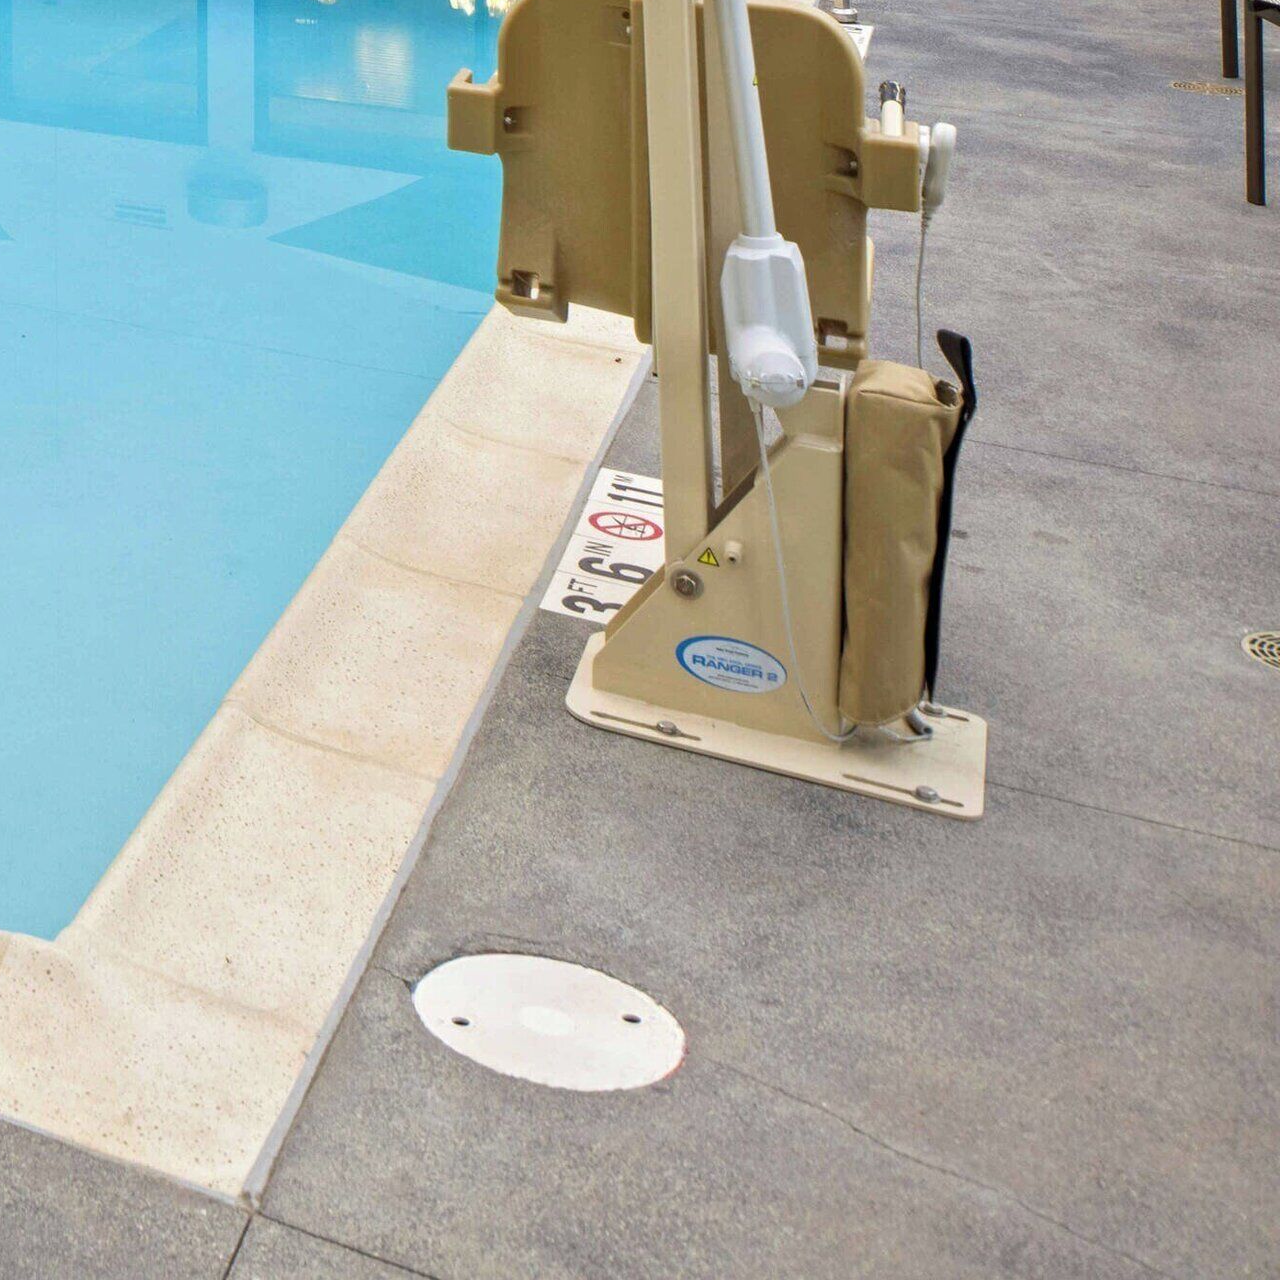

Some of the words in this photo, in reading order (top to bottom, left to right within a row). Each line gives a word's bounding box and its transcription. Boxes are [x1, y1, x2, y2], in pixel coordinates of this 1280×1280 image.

[583, 540, 613, 557] IN
[578, 556, 655, 586] 6
[567, 578, 598, 596] FT
[692, 654, 763, 679] RANGER
[767, 672, 778, 682] 2
